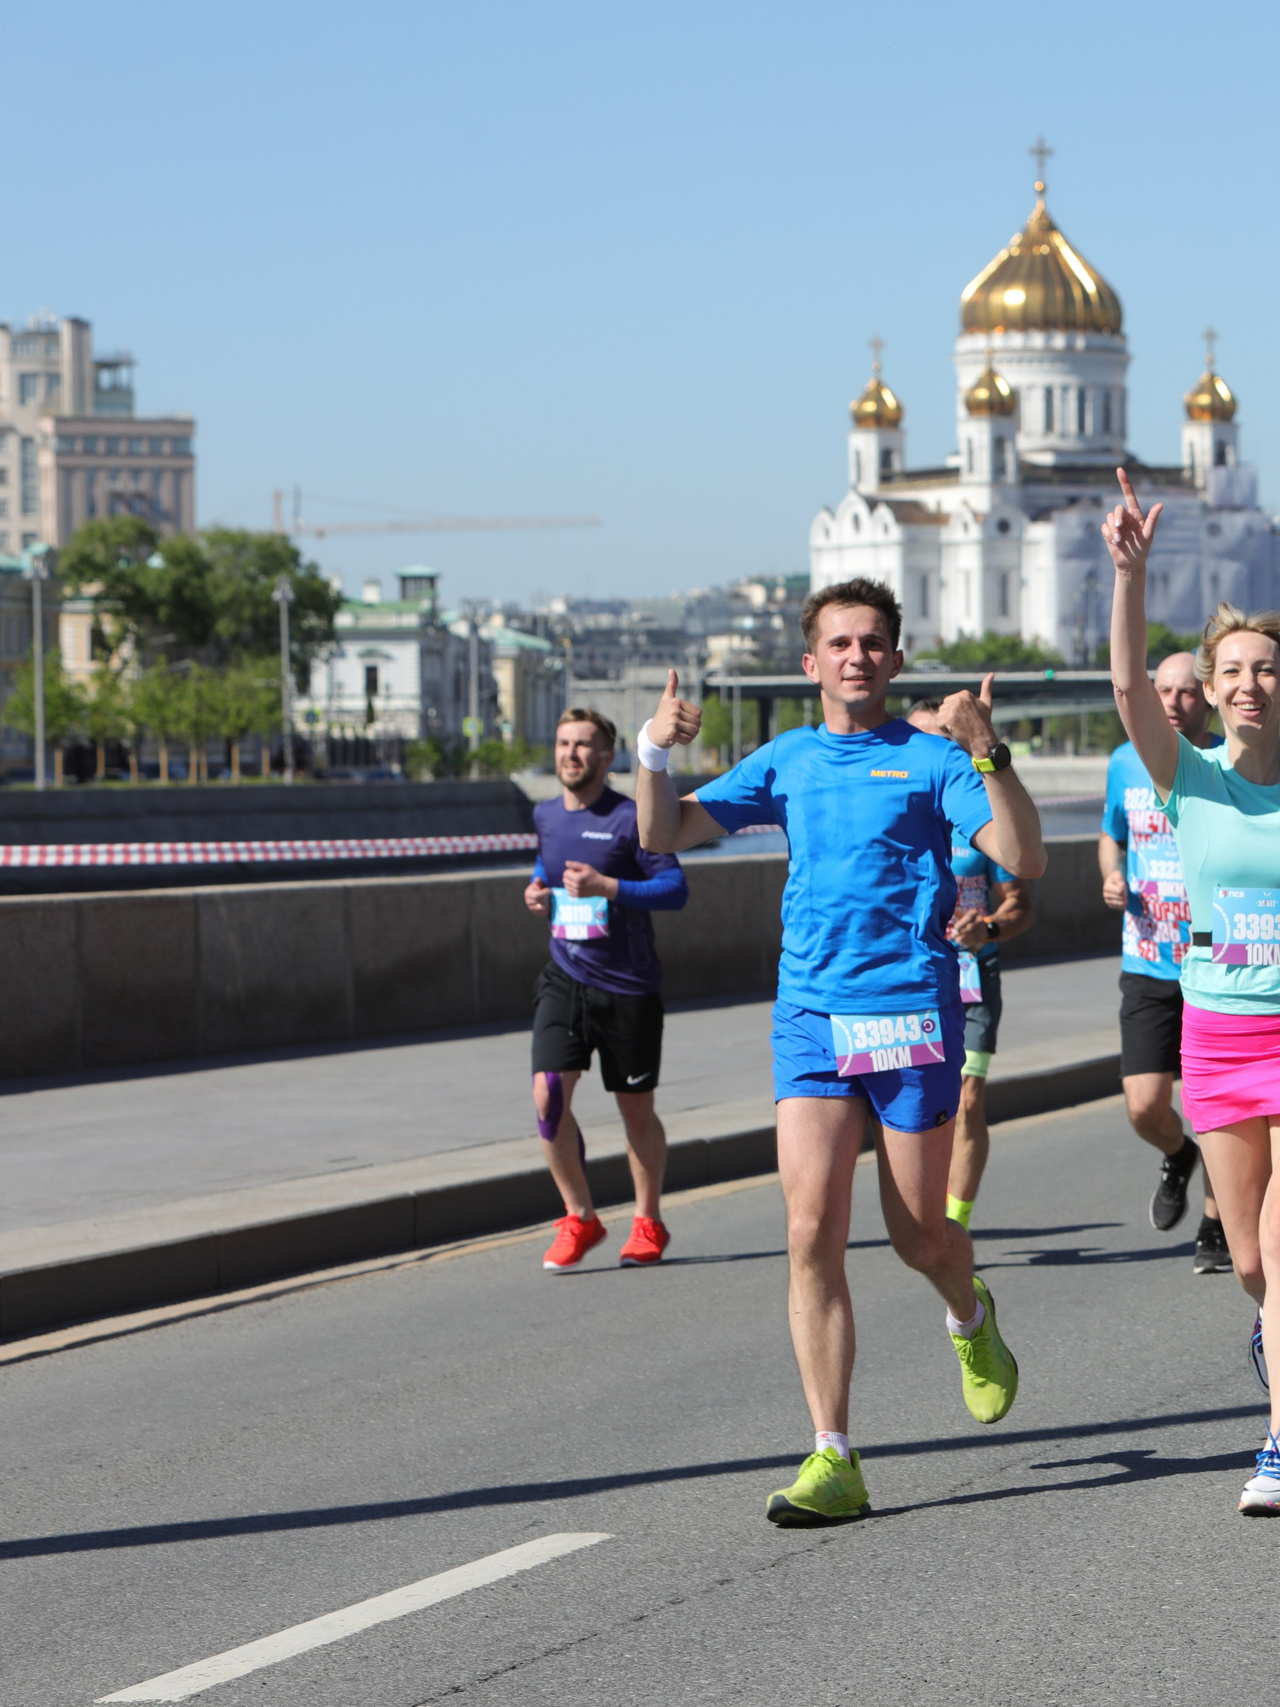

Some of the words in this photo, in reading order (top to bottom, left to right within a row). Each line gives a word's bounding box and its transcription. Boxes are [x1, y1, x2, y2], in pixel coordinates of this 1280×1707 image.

[870, 769, 909, 779] METRO
[1229, 890, 1245, 898] ПСБ
[852, 1014, 922, 1050] 33943
[869, 1046, 913, 1073] 10KM
